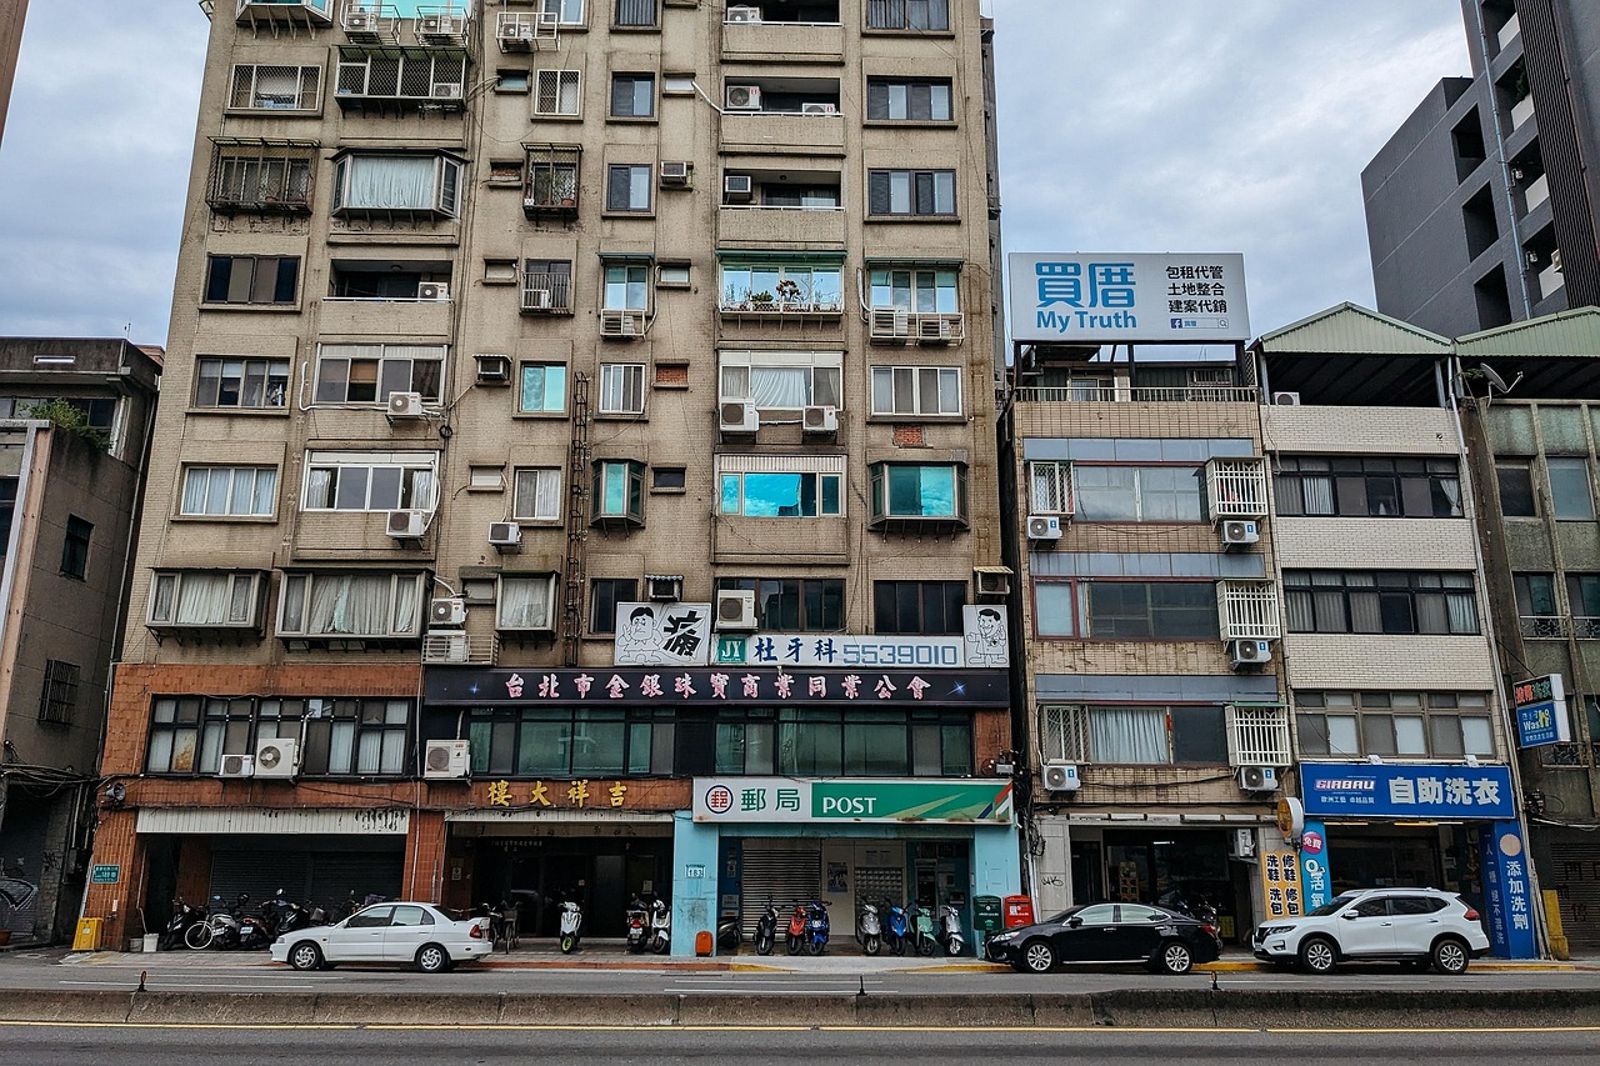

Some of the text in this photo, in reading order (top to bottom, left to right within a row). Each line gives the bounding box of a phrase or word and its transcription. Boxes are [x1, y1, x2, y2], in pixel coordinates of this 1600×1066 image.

[1165, 266, 1224, 279] 包租代管
[1167, 282, 1225, 296] 土地整合
[1168, 299, 1227, 313] 建案代銷
[1036, 310, 1137, 333] My Truth
[721, 640, 742, 657] JY
[753, 637, 958, 665] 杜牙科 5539010
[505, 673, 931, 699] 台北市金銀珠寶商業同業公會
[741, 788, 801, 812] 郵局
[823, 796, 877, 814] POST
[1388, 776, 1501, 806] 自助洗衣
[1506, 860, 1529, 931] 添加洗劑
